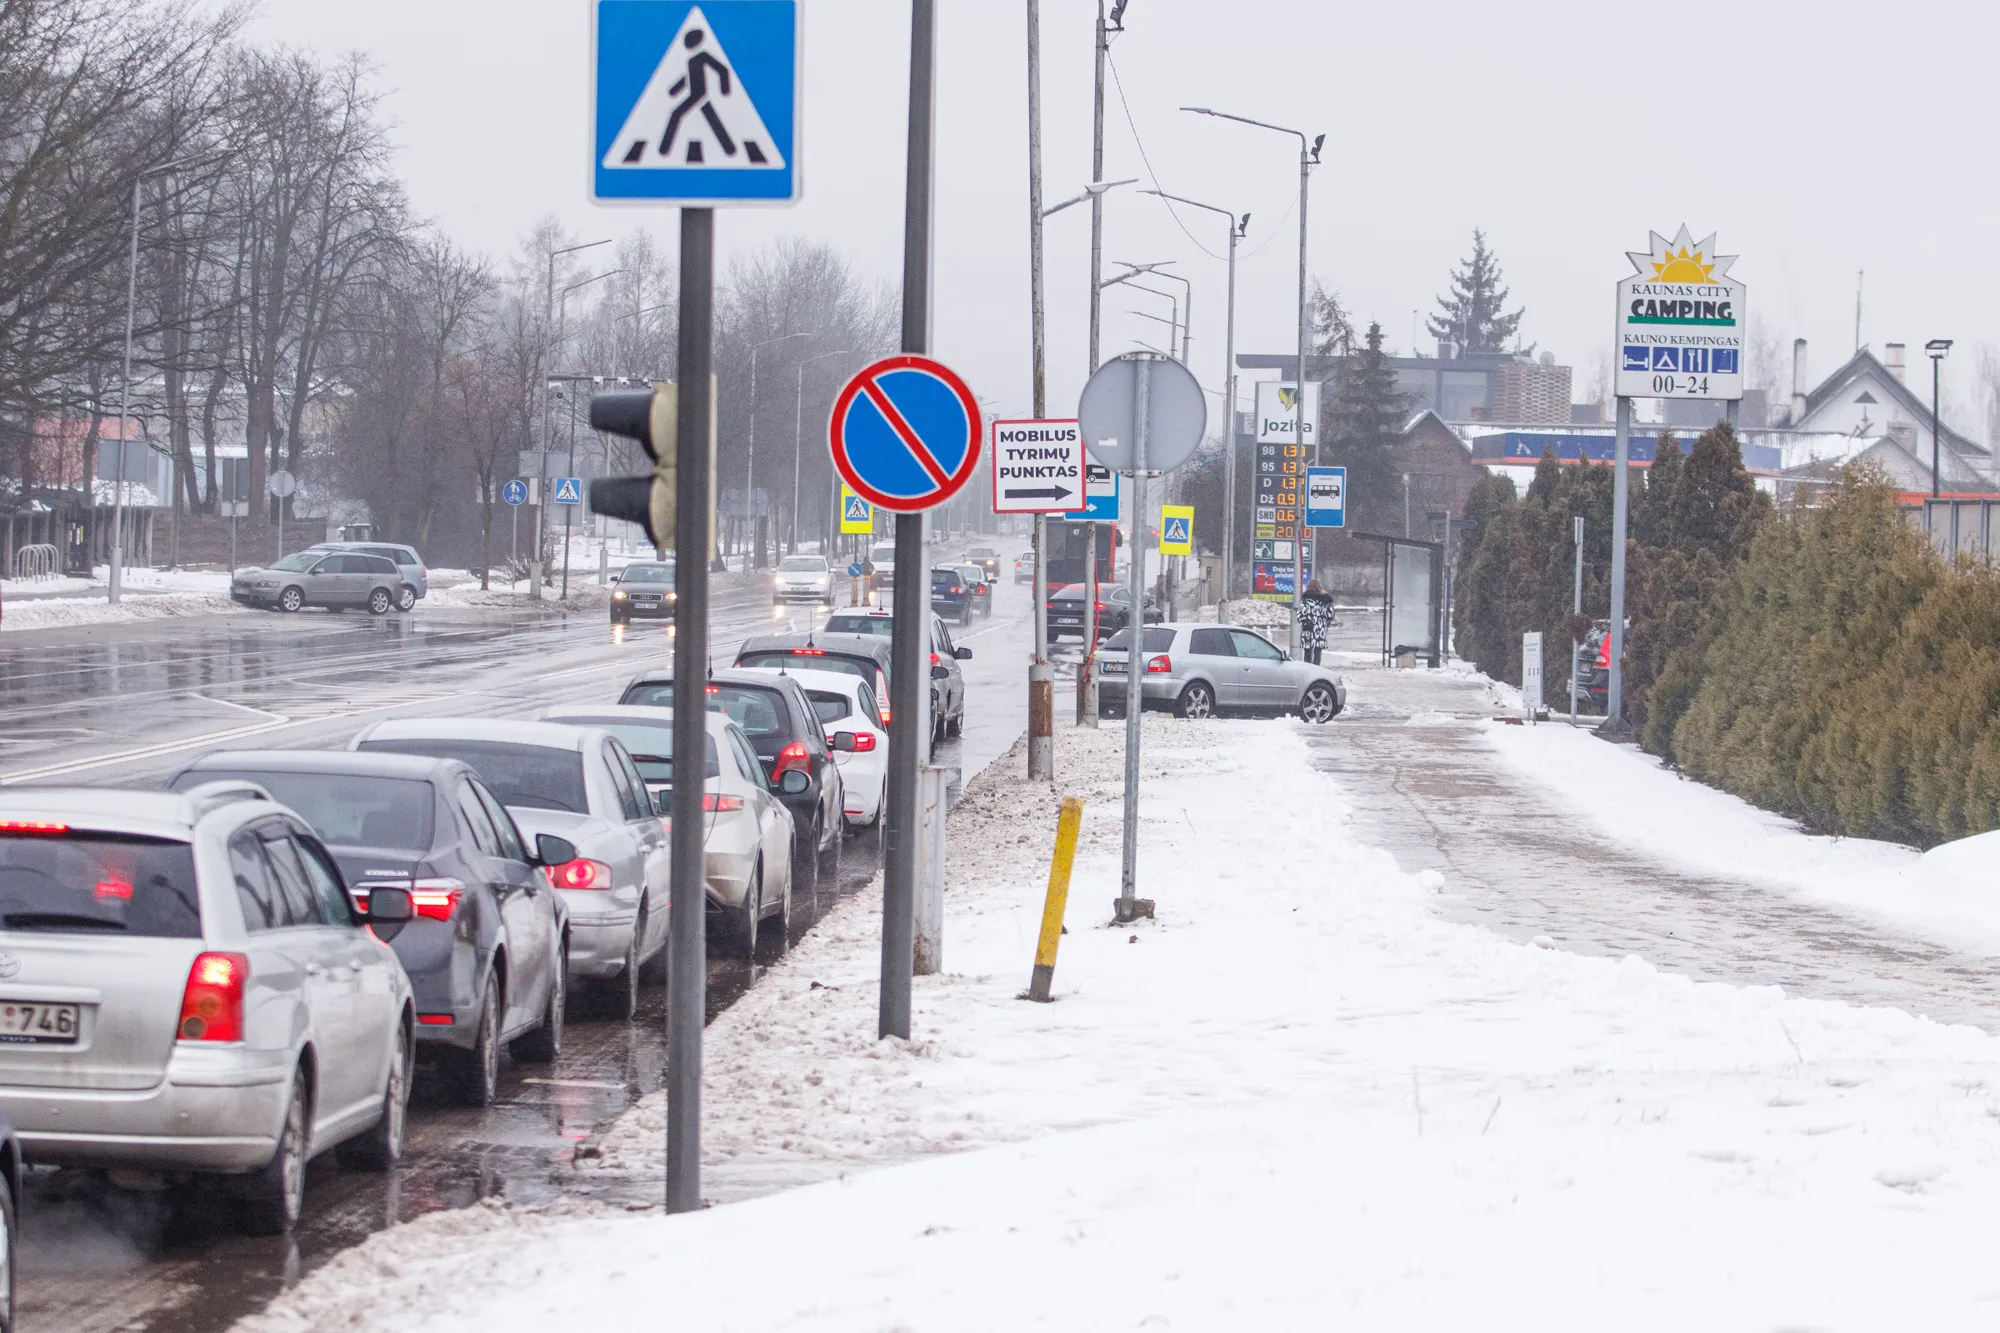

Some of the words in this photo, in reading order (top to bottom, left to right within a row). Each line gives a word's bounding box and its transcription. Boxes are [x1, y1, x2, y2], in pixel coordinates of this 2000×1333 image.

[1631, 284, 1693, 297] KAUNAS
[1697, 286, 1733, 298] CITY
[1631, 299, 1733, 320] CAMPING
[1624, 334, 1667, 344] KAUNO
[1670, 335, 1739, 346] KEMPINGAS
[1261, 418, 1312, 437] Jozia
[1000, 430, 1076, 442] MOBILUS
[1006, 447, 1070, 462] TYRIMŲ
[1262, 446, 1275, 455] 98
[1000, 465, 1078, 478] PUNKTAS
[1261, 462, 1275, 471] 95
[1263, 478, 1272, 487] D
[1260, 494, 1274, 504] Dž
[1258, 510, 1274, 520] SND
[20, 1006, 73, 1034] 746
